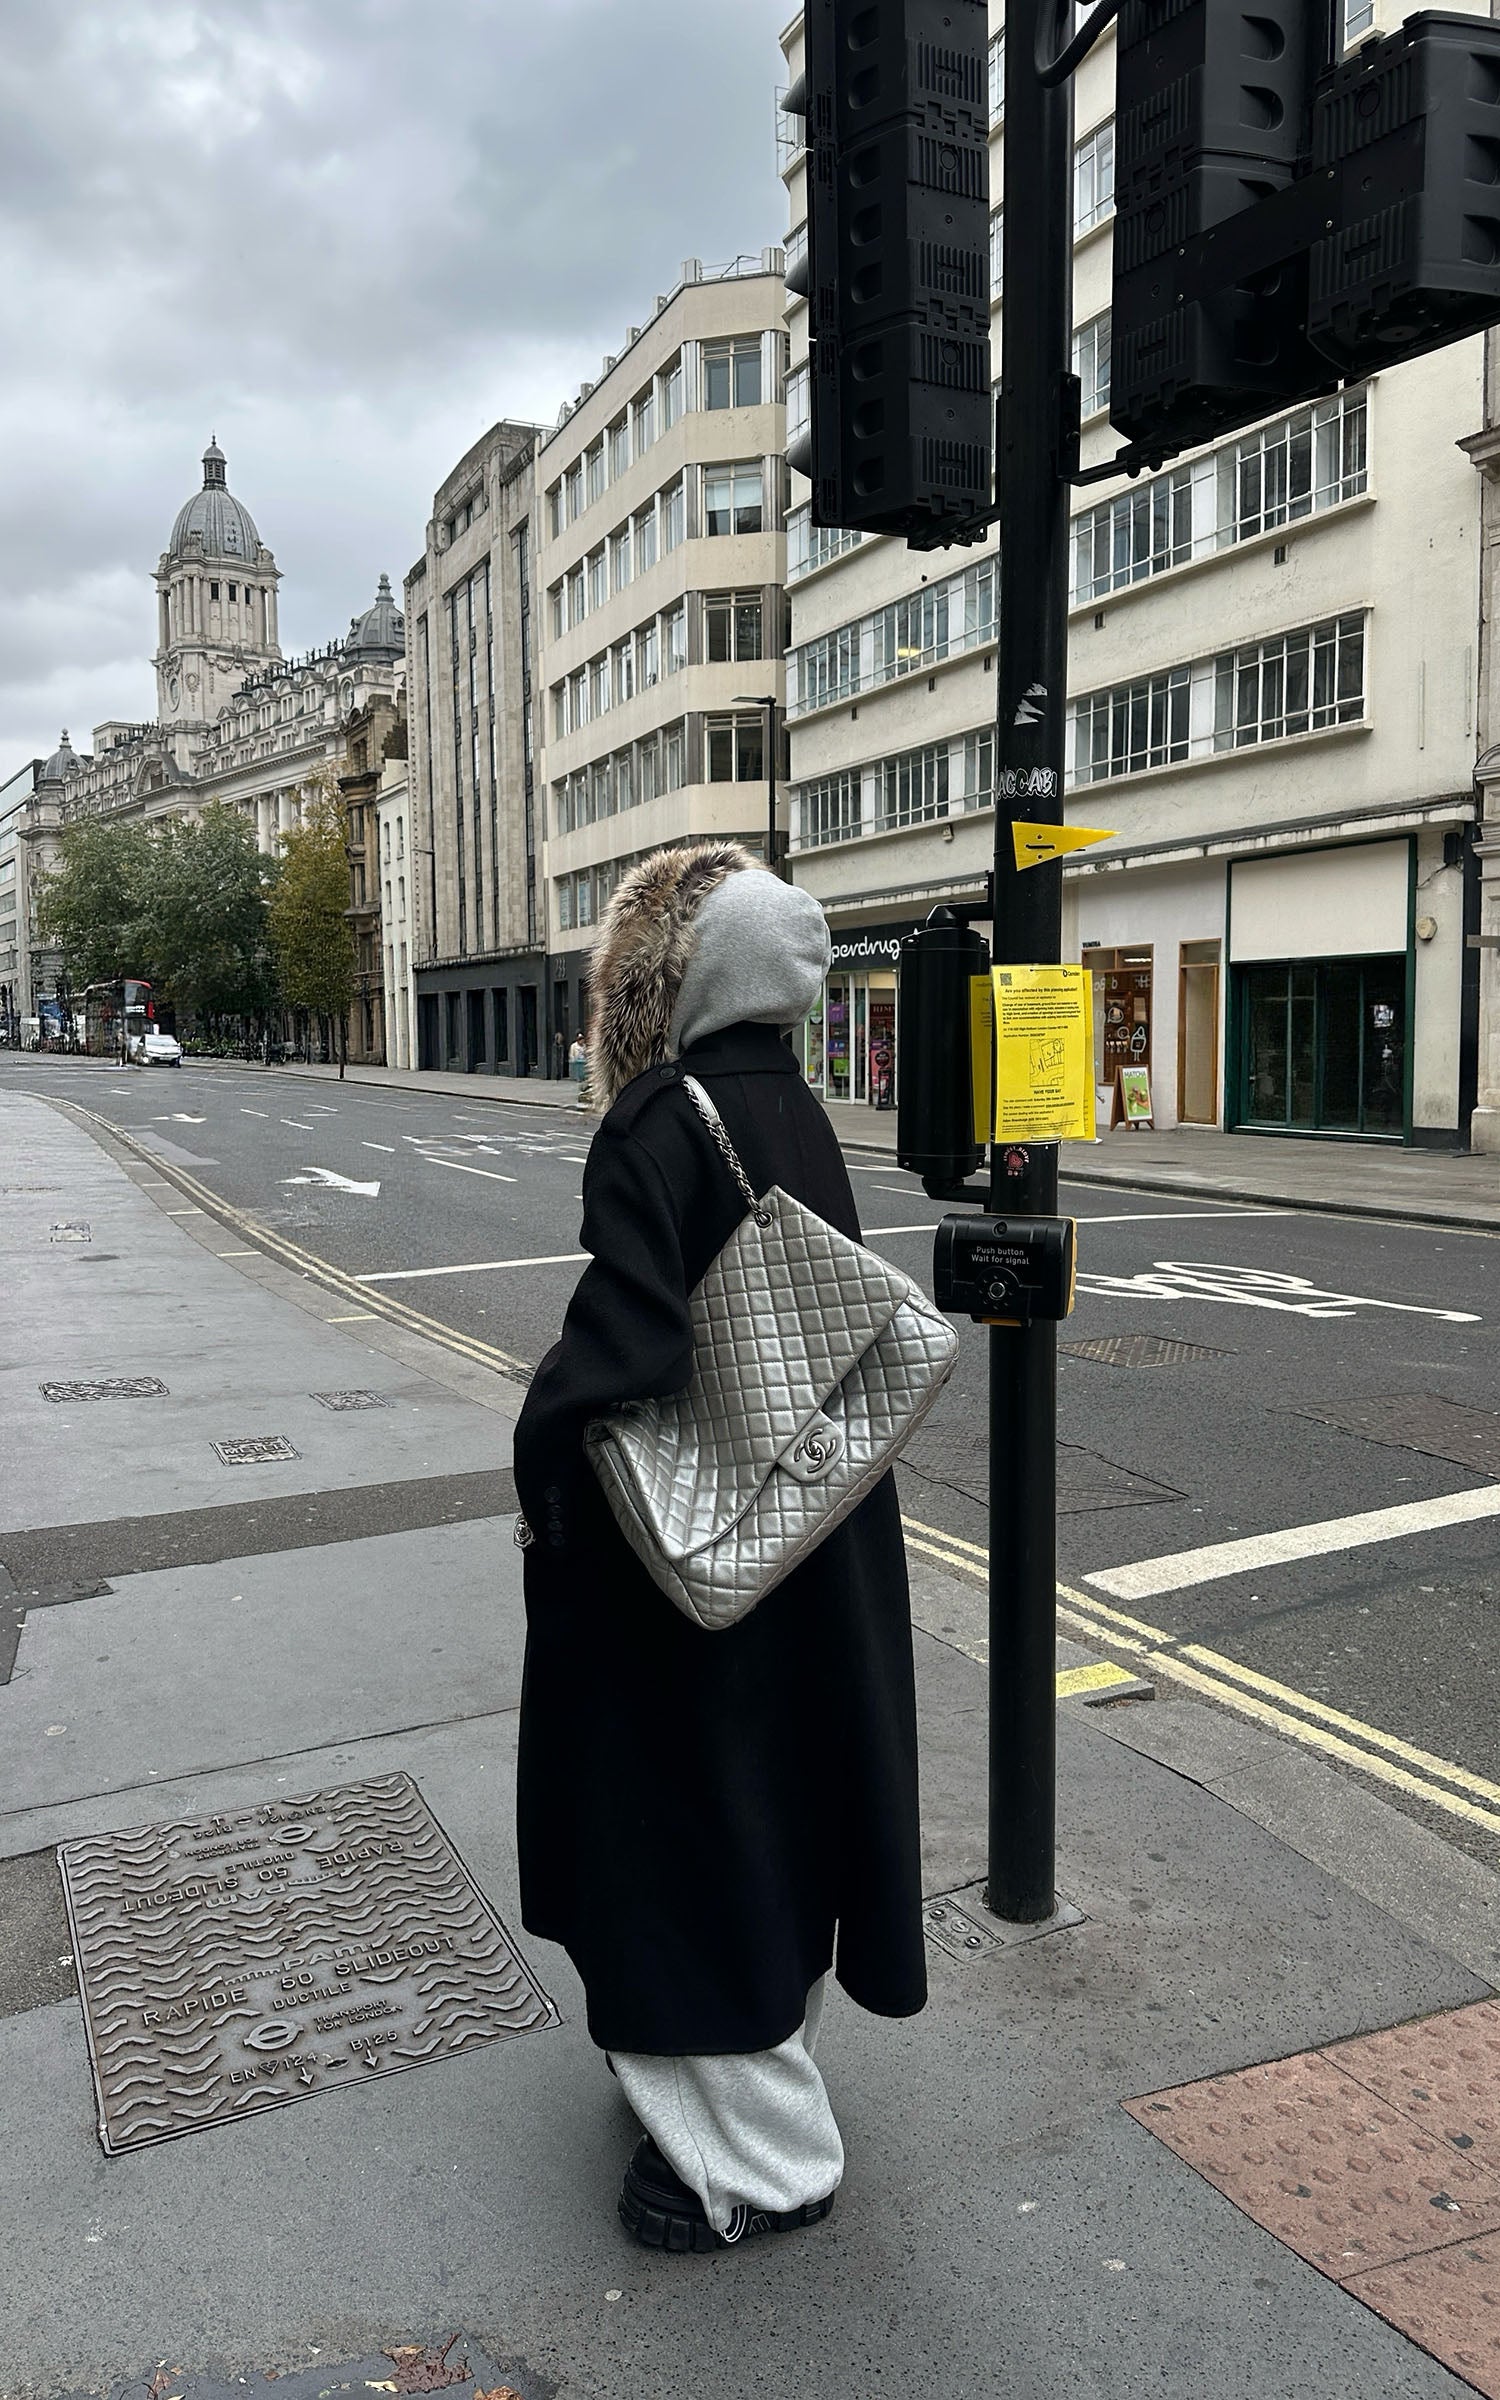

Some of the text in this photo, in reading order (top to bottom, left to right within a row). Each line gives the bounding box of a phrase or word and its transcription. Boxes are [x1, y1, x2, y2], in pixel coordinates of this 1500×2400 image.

[831, 935, 901, 965] perdrug
[971, 1254, 1029, 1265] Wait for signal
[976, 1246, 995, 1254] Push
[121, 1840, 403, 1913] RAPIDE 50 SLIDEOUT
[225, 1852, 295, 1873] DUCTILE
[142, 1937, 456, 2026] RAPIDE 50 SLIDEOUT
[273, 1982, 352, 2011] DUCTILE
[314, 2000, 387, 2025] TRANSPORT
[317, 2005, 403, 2034] FOR LONDON
[350, 2031, 398, 2052] B125
[230, 2052, 318, 2084] EN 124
